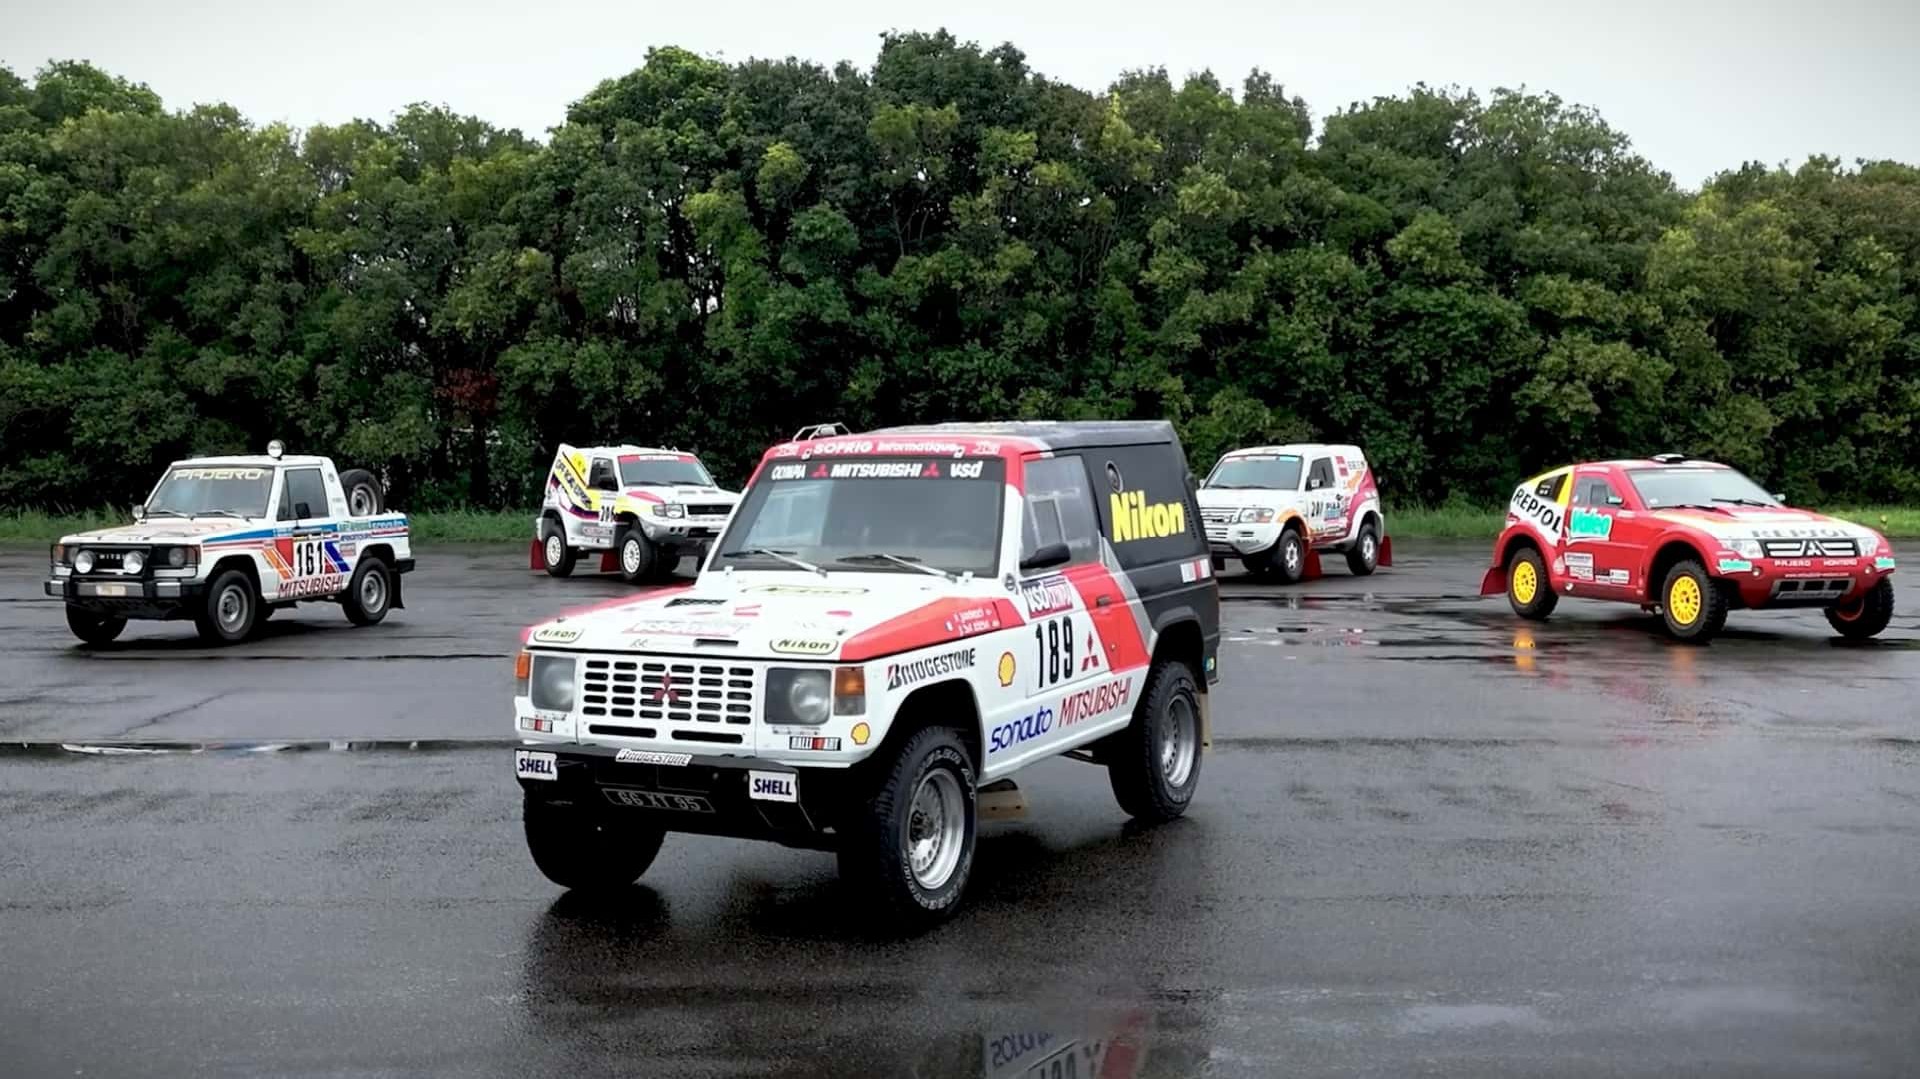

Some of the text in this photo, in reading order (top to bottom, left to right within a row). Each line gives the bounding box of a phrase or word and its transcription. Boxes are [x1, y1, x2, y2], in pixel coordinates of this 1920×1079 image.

[830, 463, 923, 477] MITSUBISHI
[1110, 490, 1185, 543] Nikon
[1513, 488, 1562, 534] REPSOL
[297, 541, 323, 577] 161
[279, 574, 344, 597] MITSUBISHI
[777, 638, 830, 650] Nikon
[1035, 616, 1074, 688] 189
[887, 647, 976, 691] BRIDGESTONE
[1058, 677, 1132, 728] MITSUBISHI
[989, 706, 1053, 754] sonauto
[519, 757, 553, 775] SHELL
[753, 777, 793, 796] SHELL
